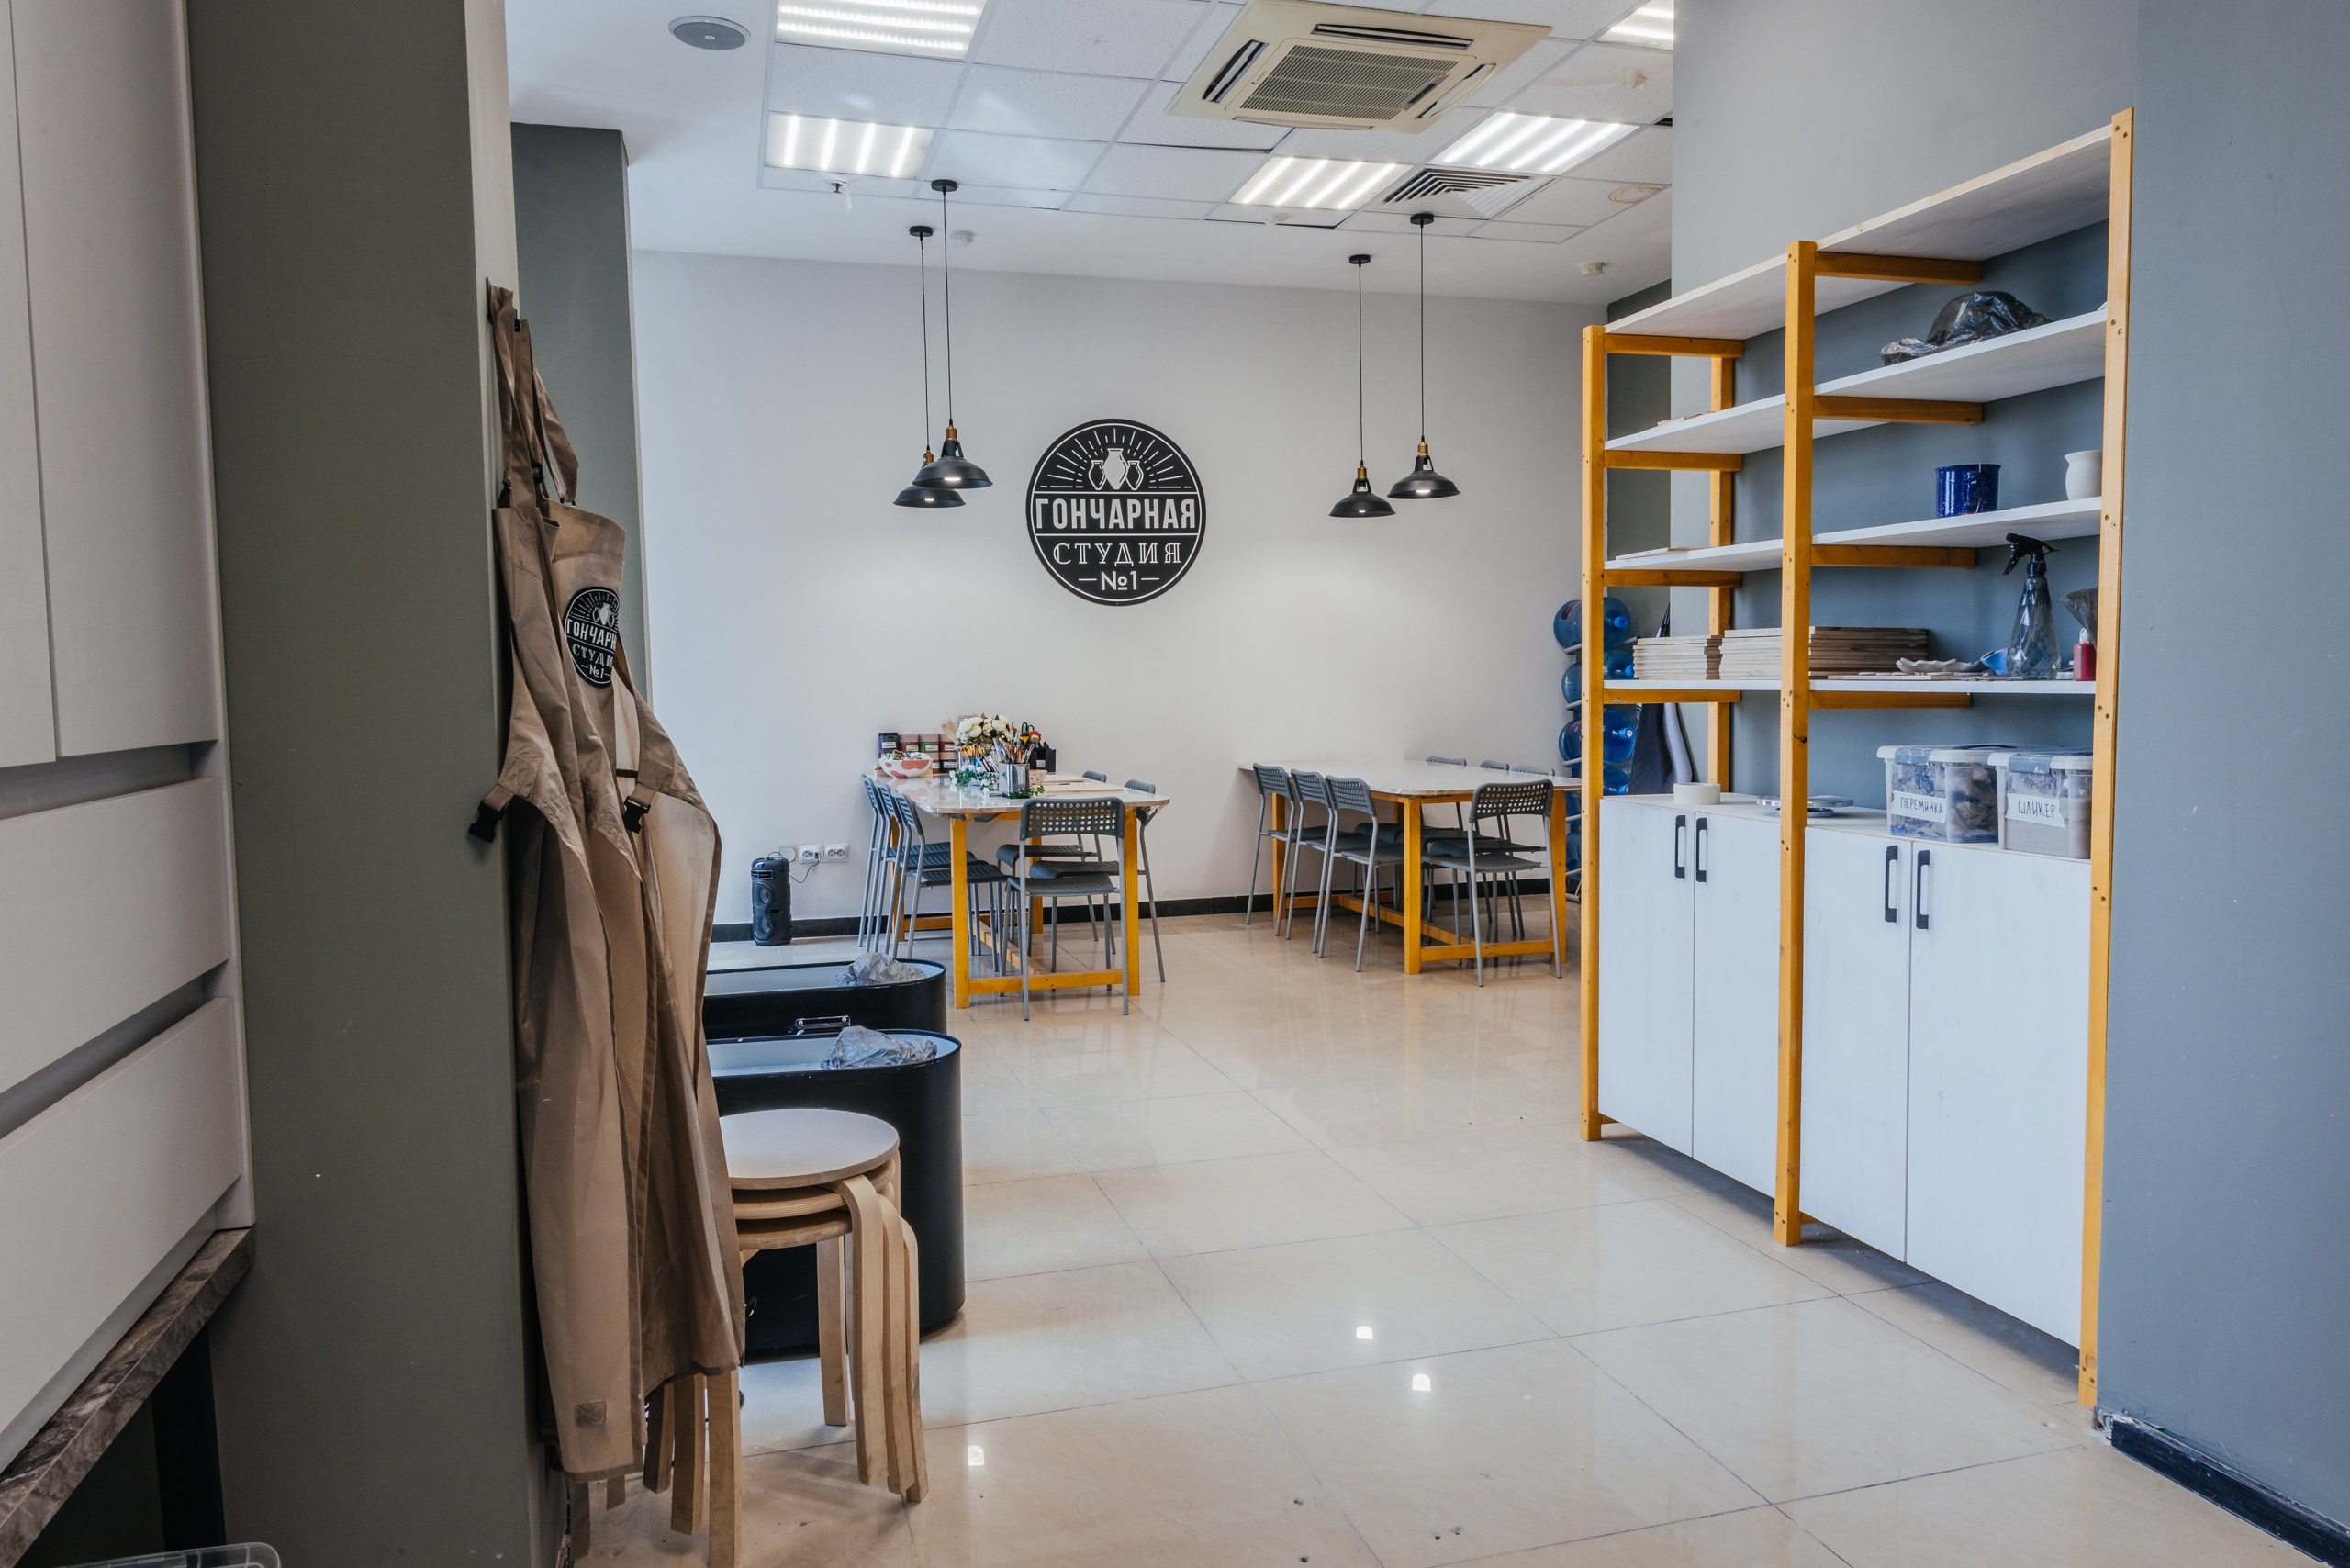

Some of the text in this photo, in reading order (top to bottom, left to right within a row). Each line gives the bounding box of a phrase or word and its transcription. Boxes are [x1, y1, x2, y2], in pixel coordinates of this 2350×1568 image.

[1035, 498, 1196, 529] ГОНЧАРНАЯ
[1053, 543, 1181, 567] СТУДИЯ
[1101, 570, 1137, 590] №1
[1900, 797, 1944, 814] ПЕРЕМИНКА
[2018, 800, 2056, 818] ШЛИКЕР
